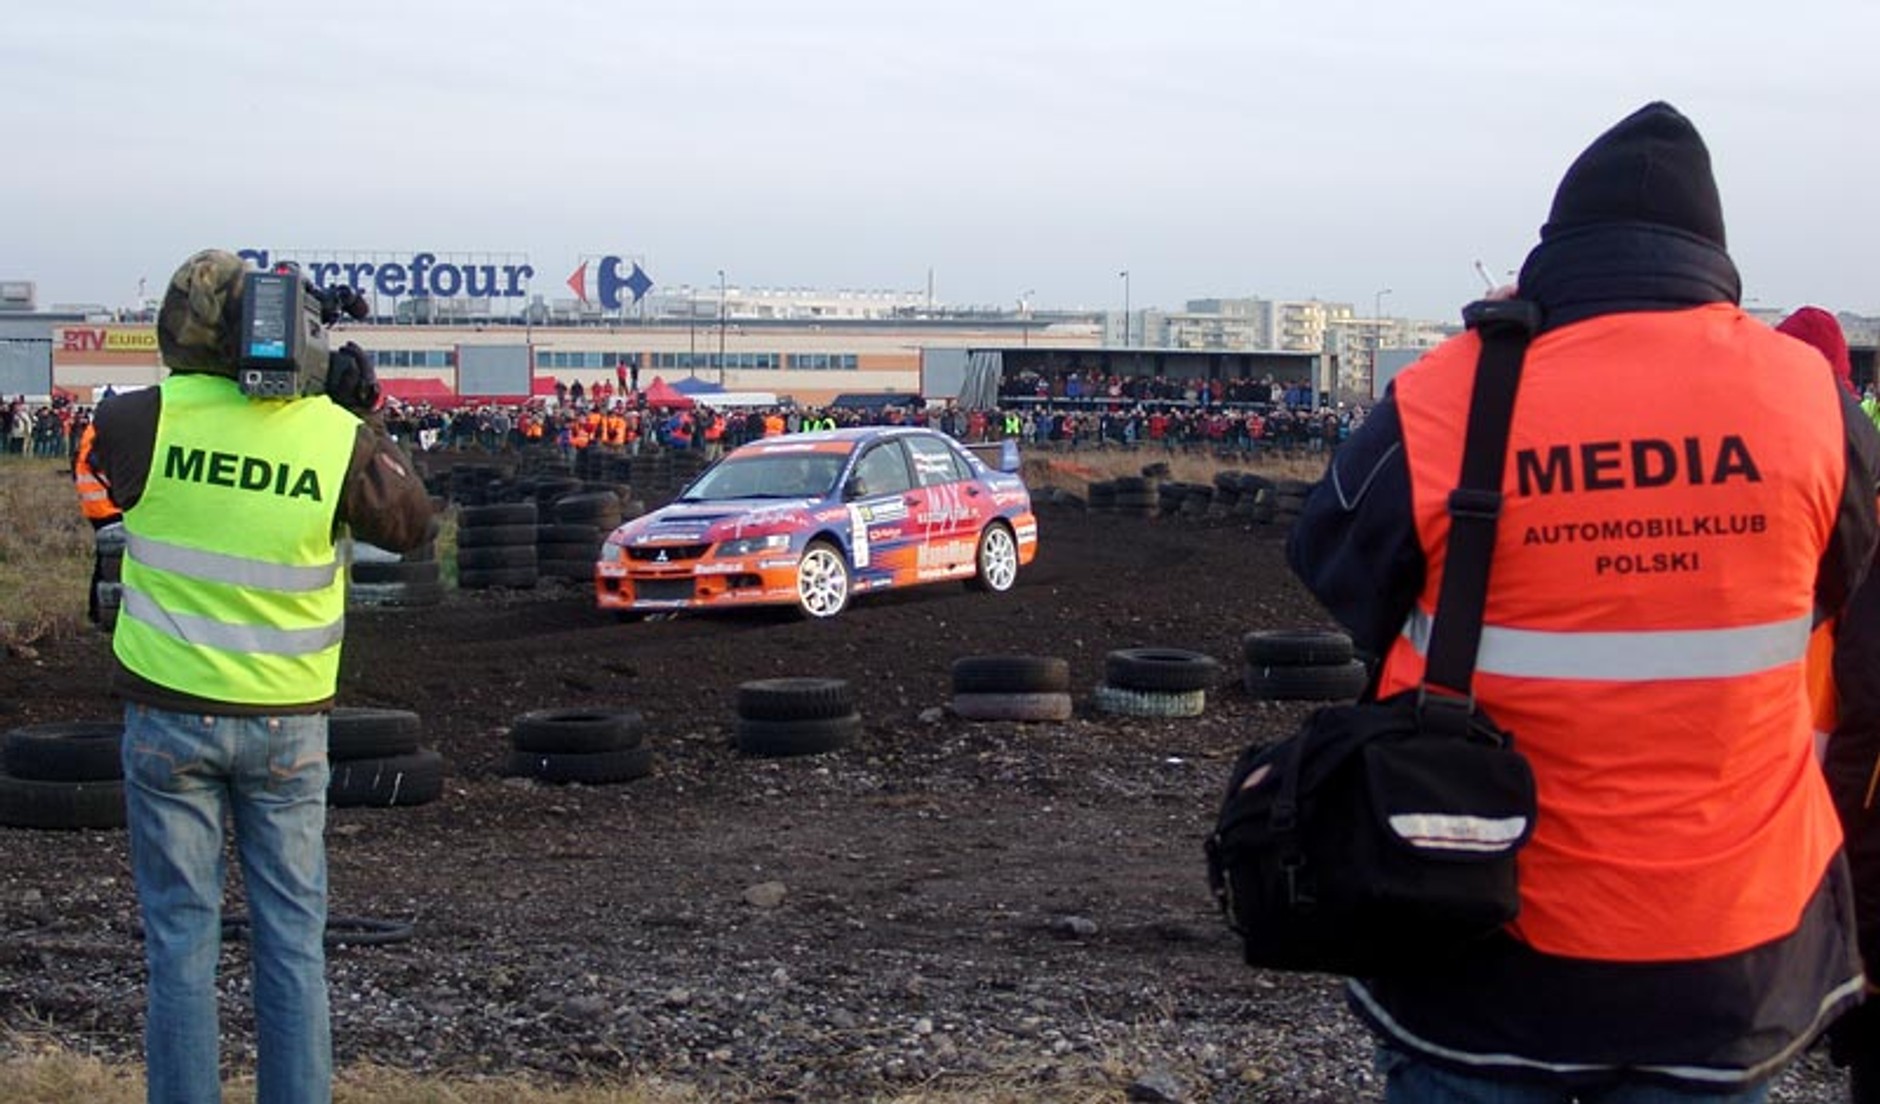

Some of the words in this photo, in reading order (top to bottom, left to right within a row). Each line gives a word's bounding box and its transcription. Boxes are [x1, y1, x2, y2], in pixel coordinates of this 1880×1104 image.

[237, 249, 534, 298] rrefour
[63, 330, 107, 351] RTV
[108, 334, 156, 346] EURO
[164, 445, 323, 502] MEDIA
[1516, 434, 1763, 497] MEDIA
[1523, 514, 1767, 546] AUTOMOBILKLUB
[1595, 552, 1700, 575] POLSKI
